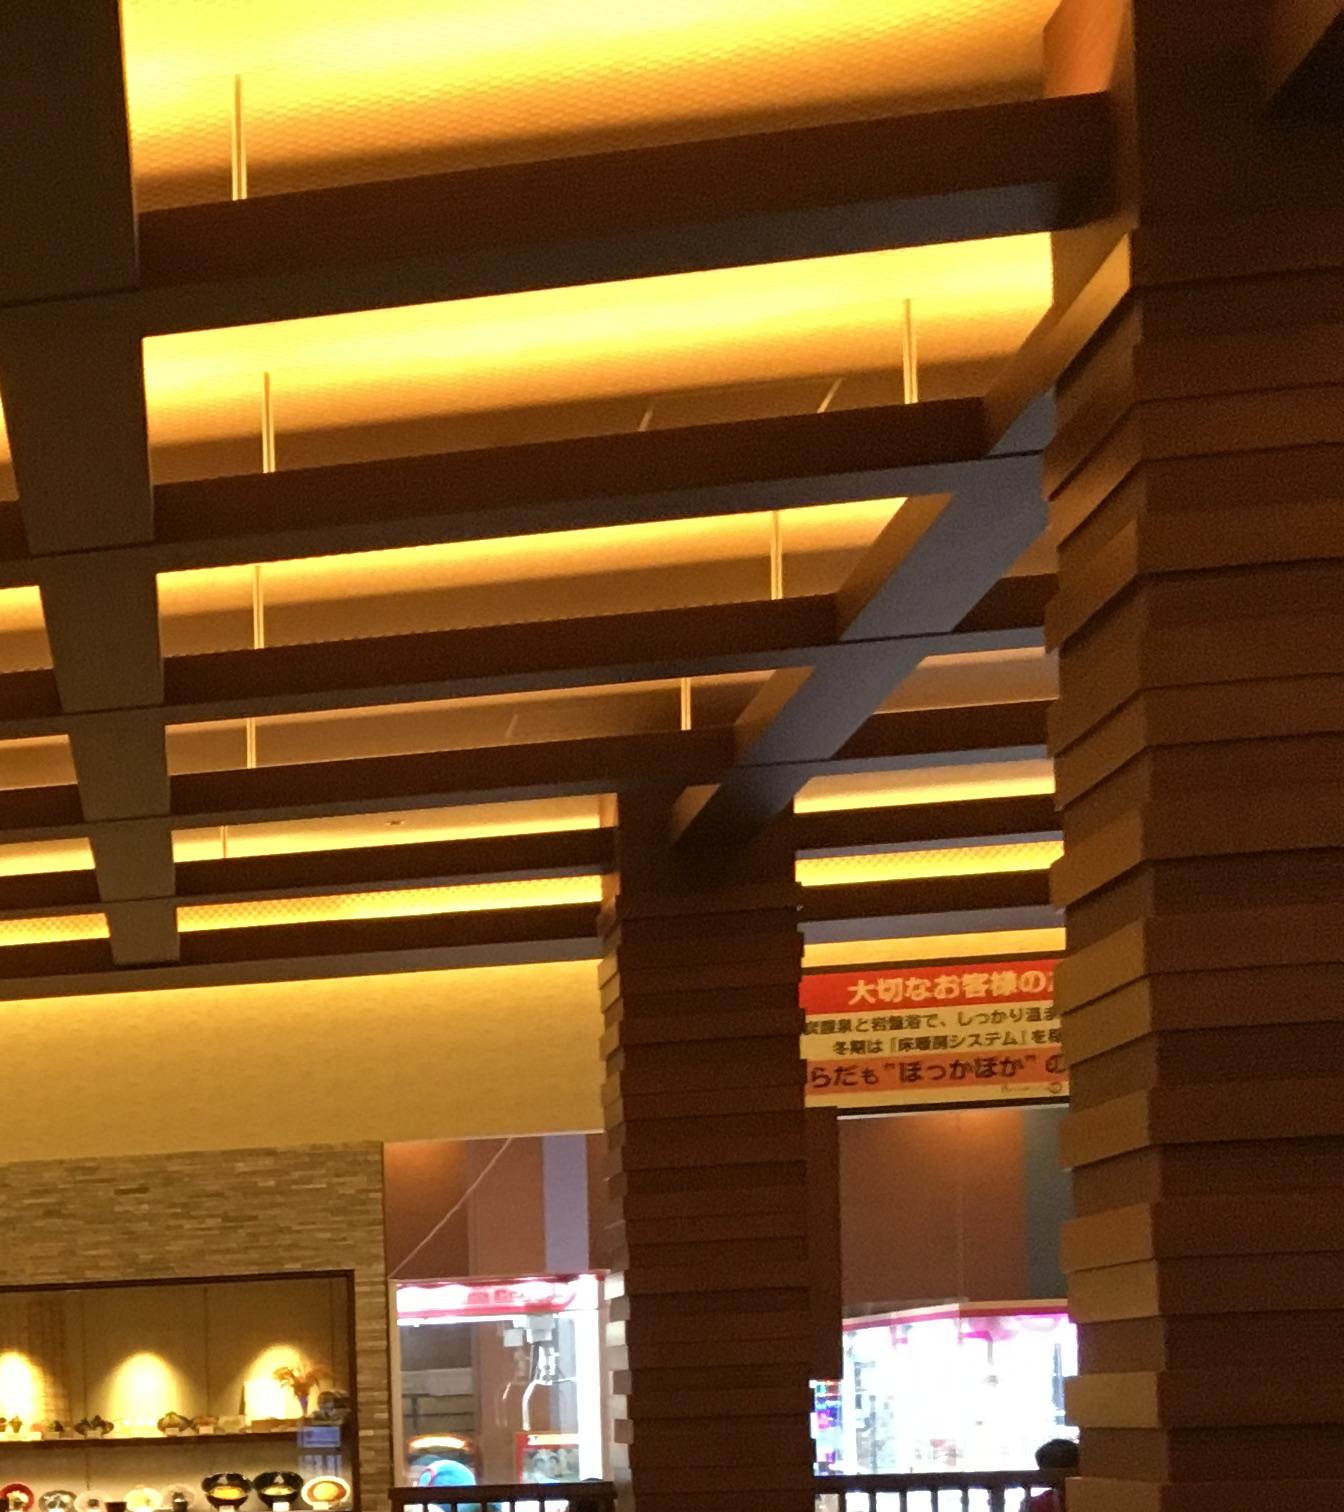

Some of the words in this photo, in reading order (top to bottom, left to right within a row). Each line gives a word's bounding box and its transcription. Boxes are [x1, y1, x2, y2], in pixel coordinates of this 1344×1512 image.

[847, 970, 1054, 1006] 大切なお客様の
